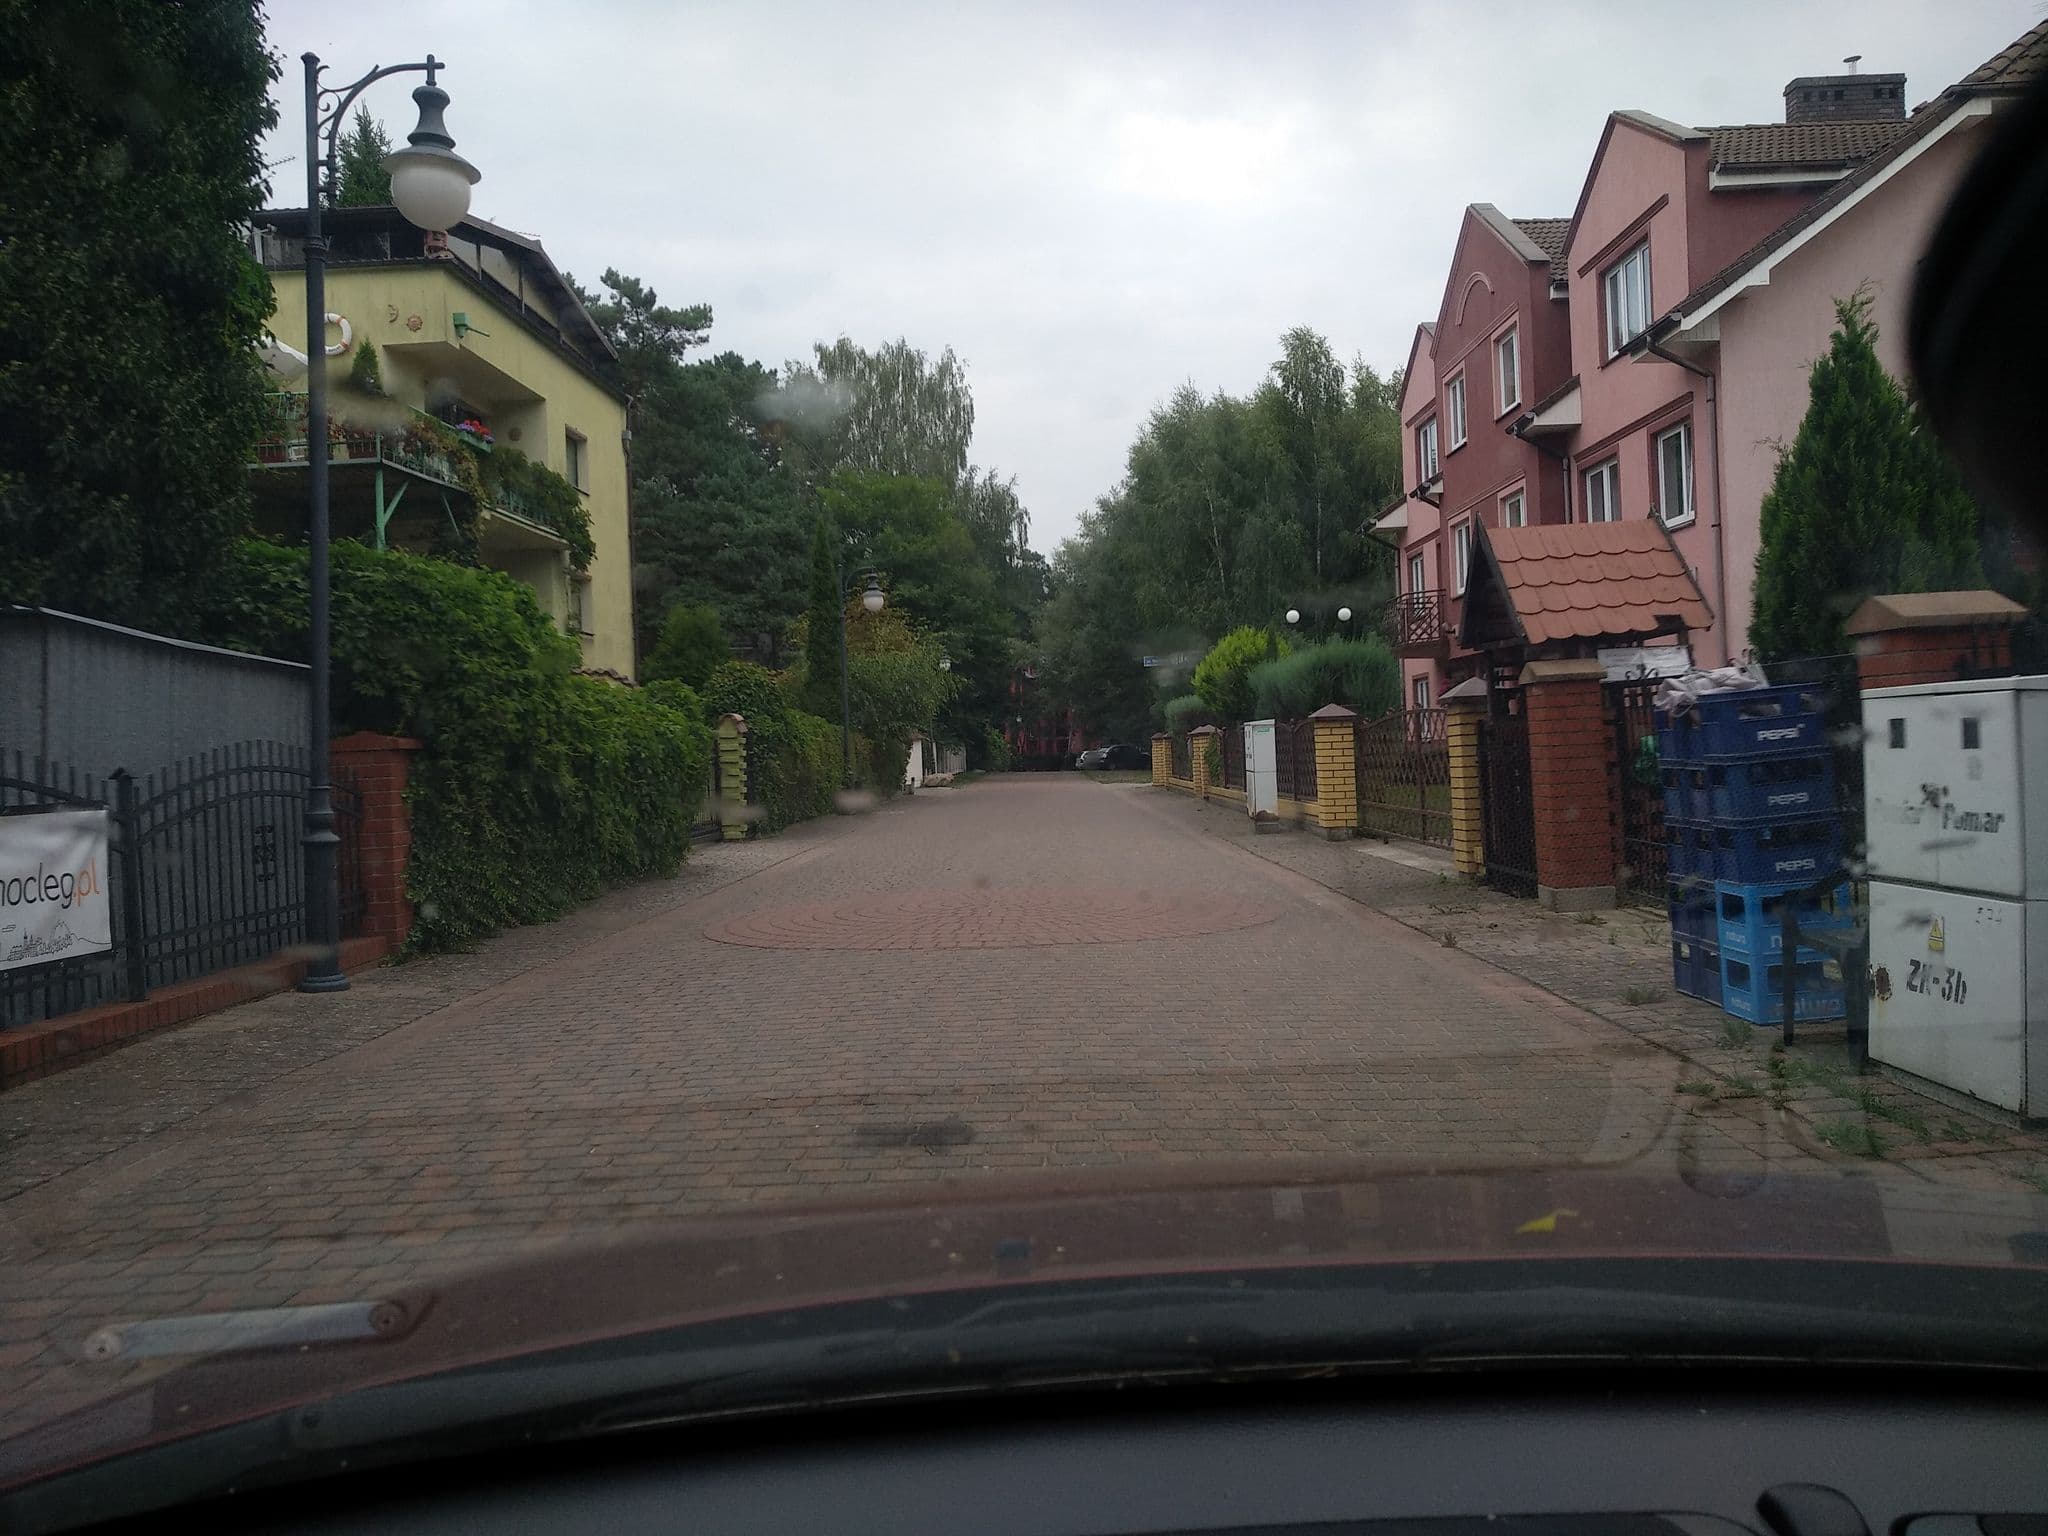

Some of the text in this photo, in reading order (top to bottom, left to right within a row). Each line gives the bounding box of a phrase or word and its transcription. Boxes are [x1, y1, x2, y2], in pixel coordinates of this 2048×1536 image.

[1756, 727, 1800, 741] PEPSI
[1767, 792, 1809, 806] PEPSI
[1775, 858, 1817, 872] PEPSI
